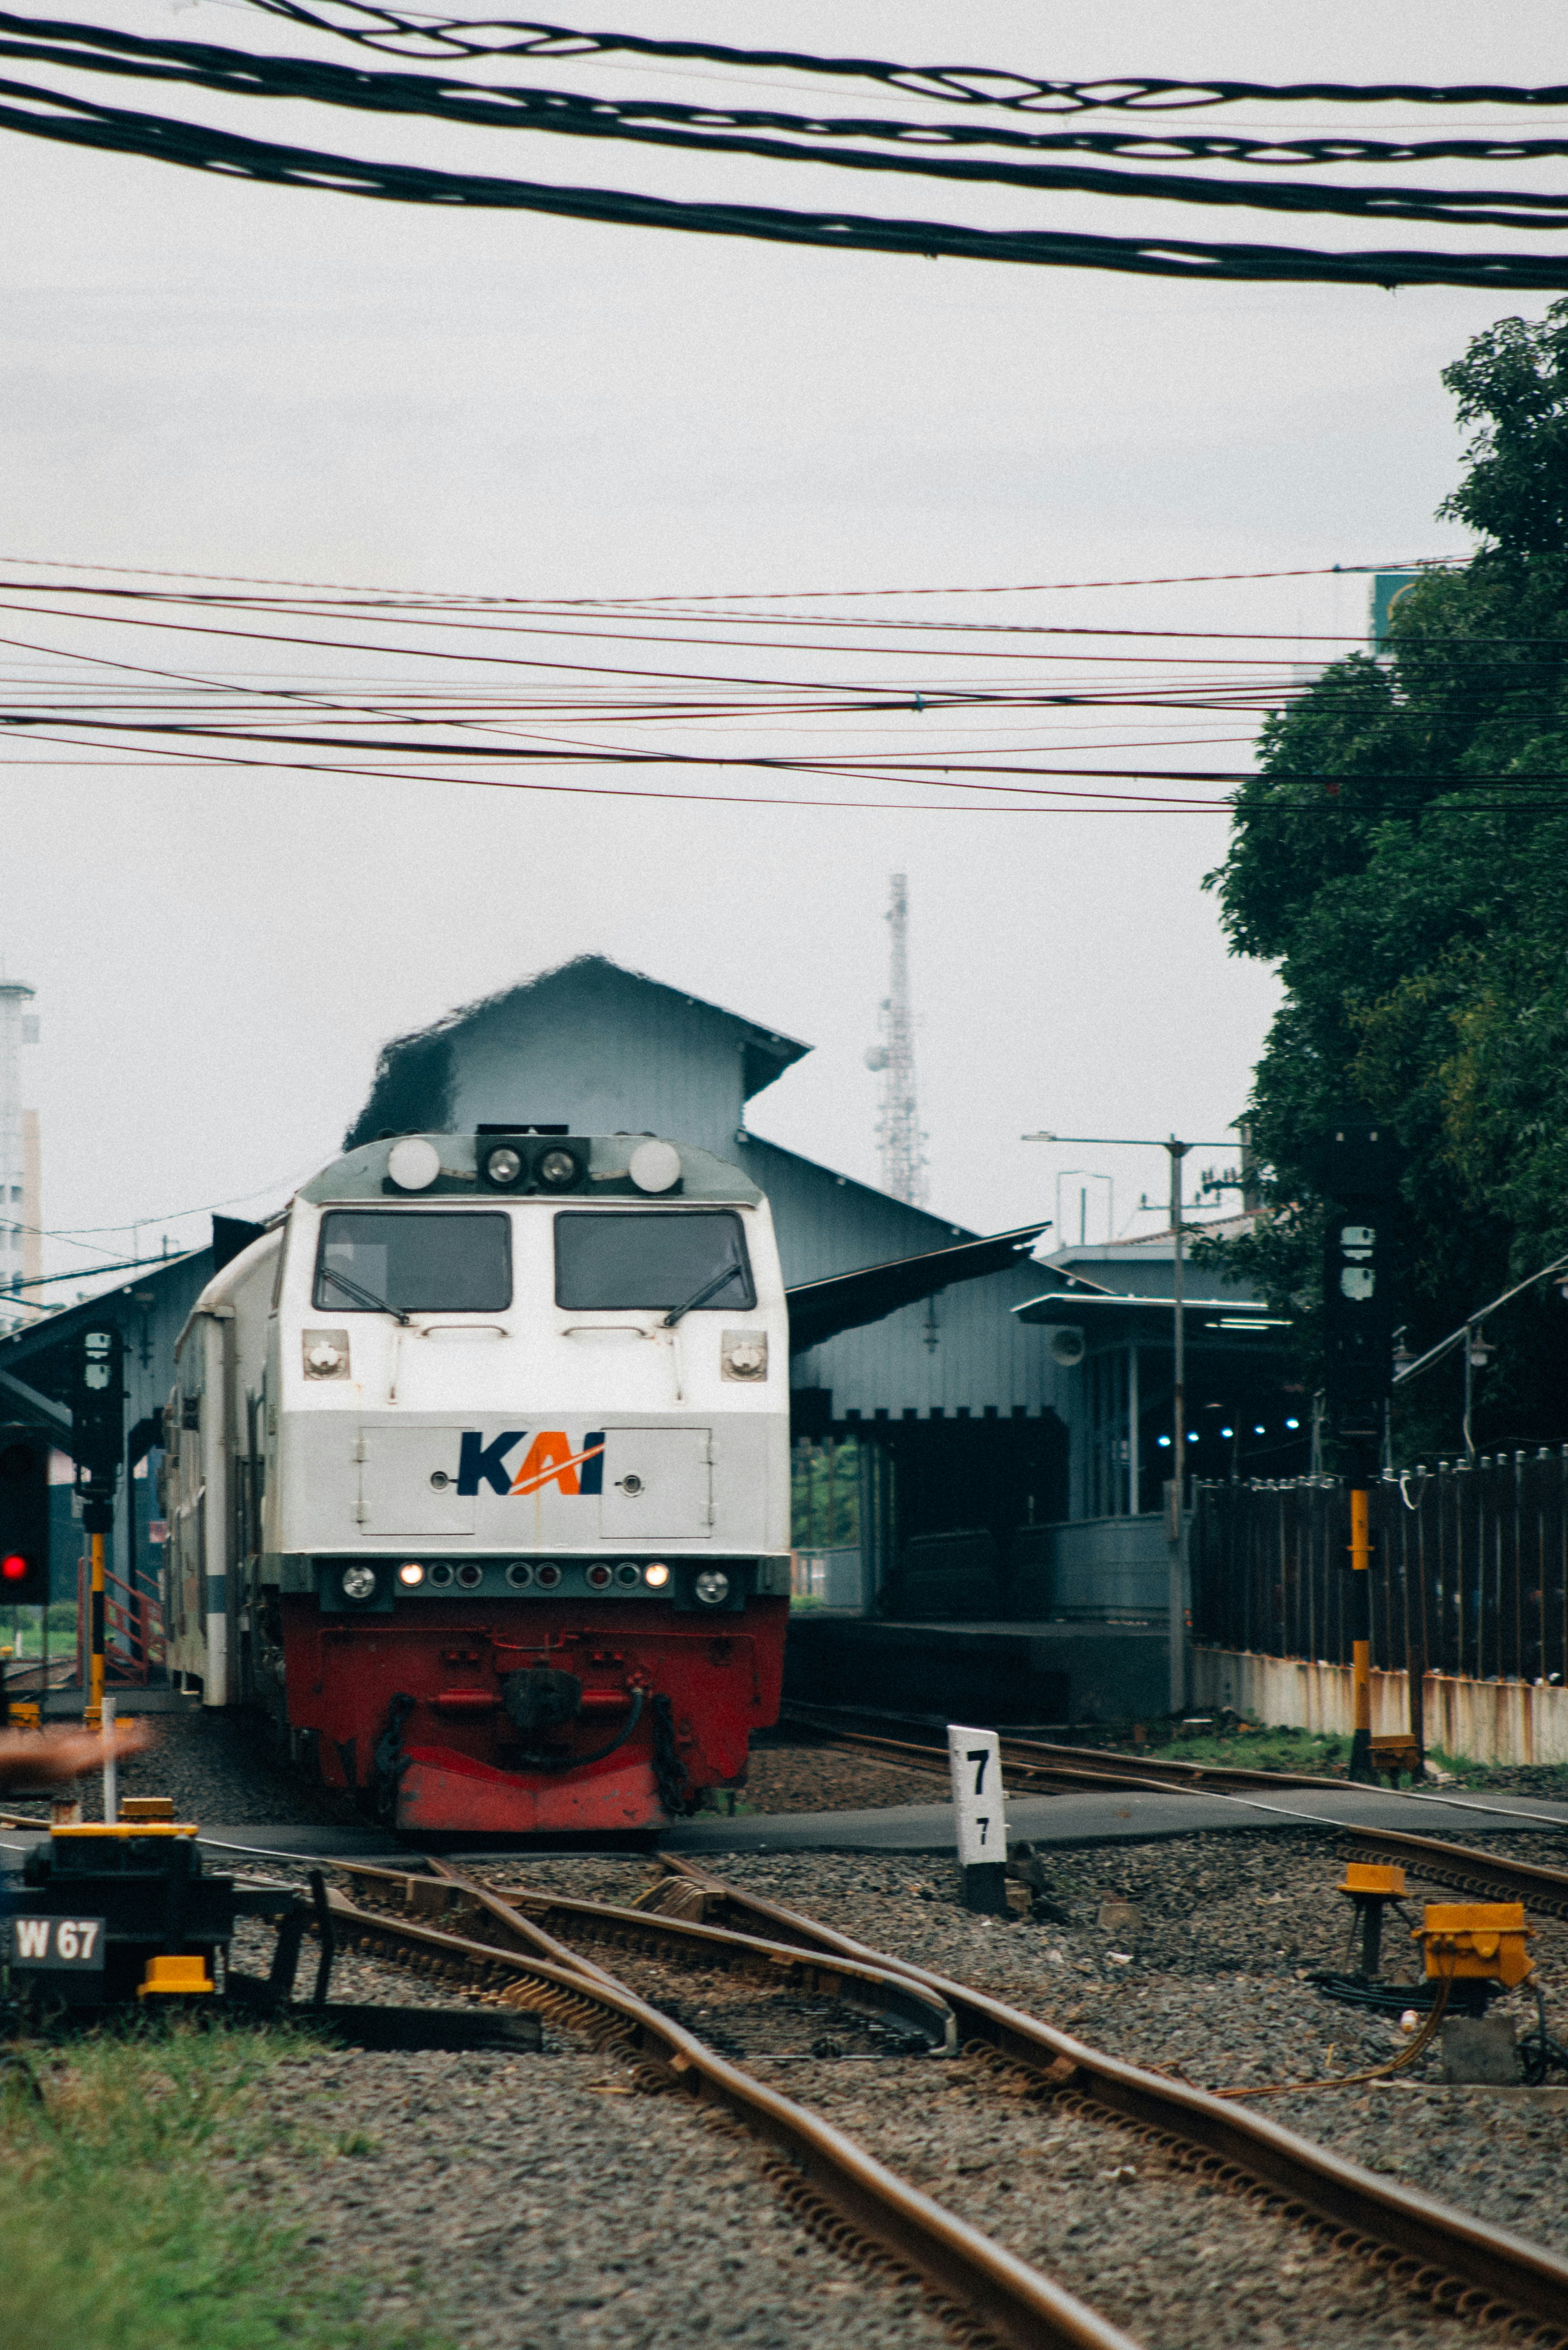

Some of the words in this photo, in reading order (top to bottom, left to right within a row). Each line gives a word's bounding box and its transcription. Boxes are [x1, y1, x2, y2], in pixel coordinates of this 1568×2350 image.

[457, 1431, 605, 1496] KAI
[967, 1749, 989, 1795] 7
[976, 1818, 989, 1845] 7
[16, 1920, 50, 1958] W
[56, 1920, 99, 1959] 67
